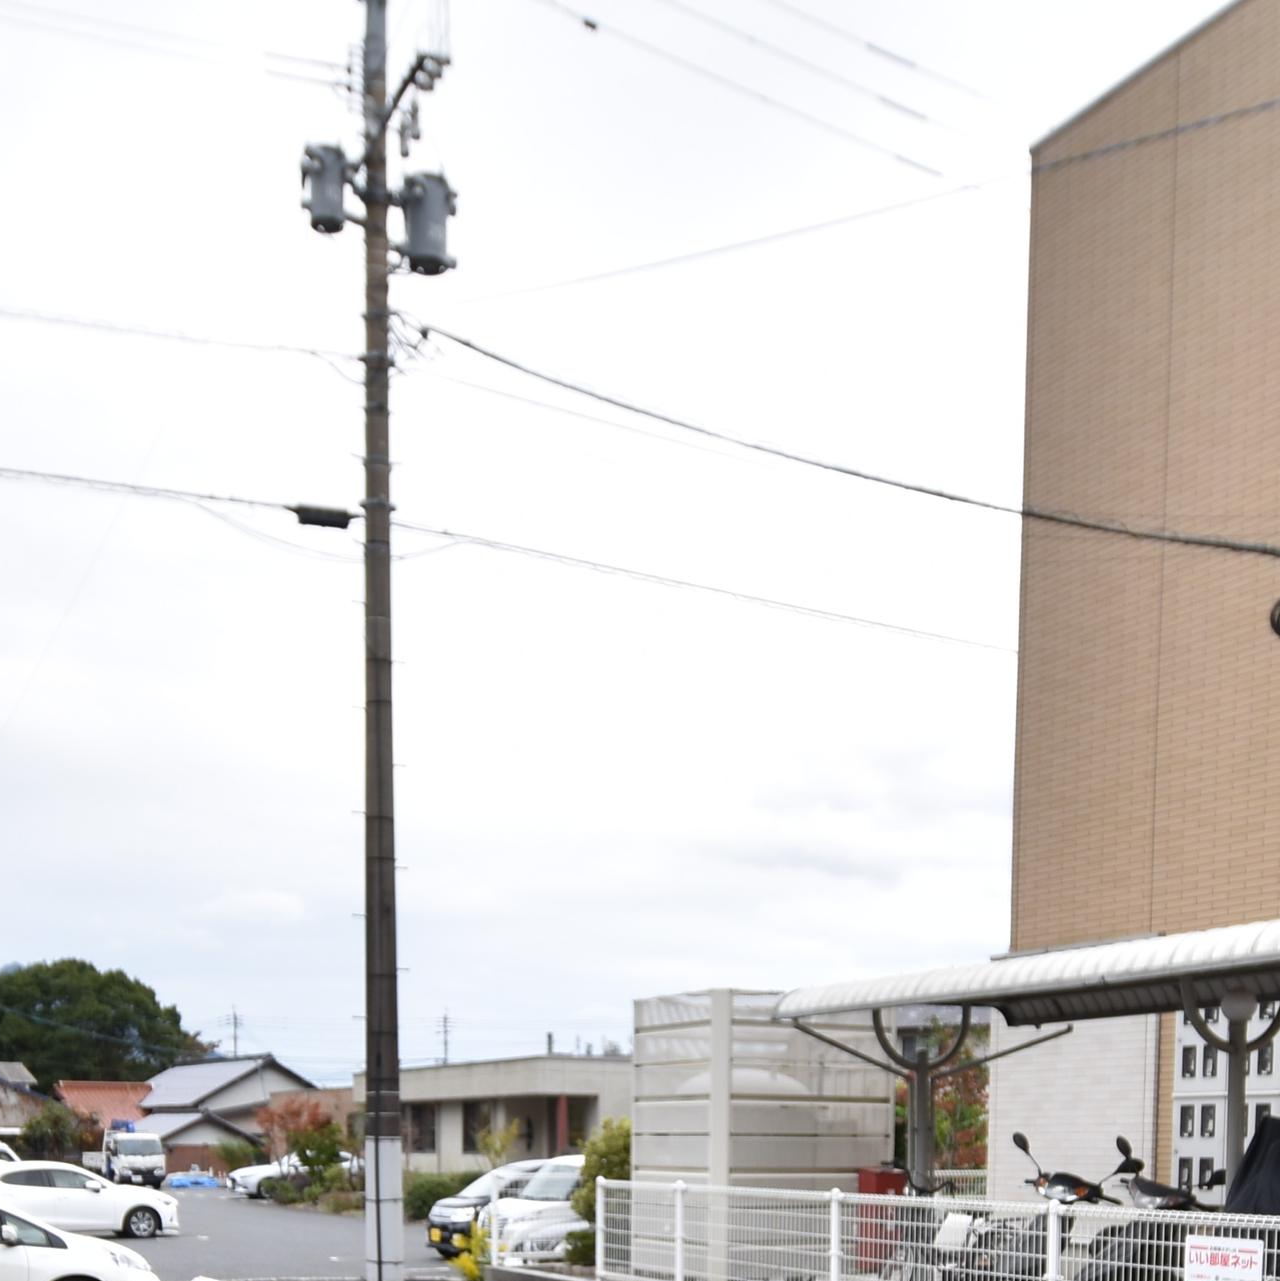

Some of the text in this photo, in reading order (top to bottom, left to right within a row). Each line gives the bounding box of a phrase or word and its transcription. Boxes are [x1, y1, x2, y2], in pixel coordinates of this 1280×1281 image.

[1189, 1251, 1258, 1270] いい部屋ネット
